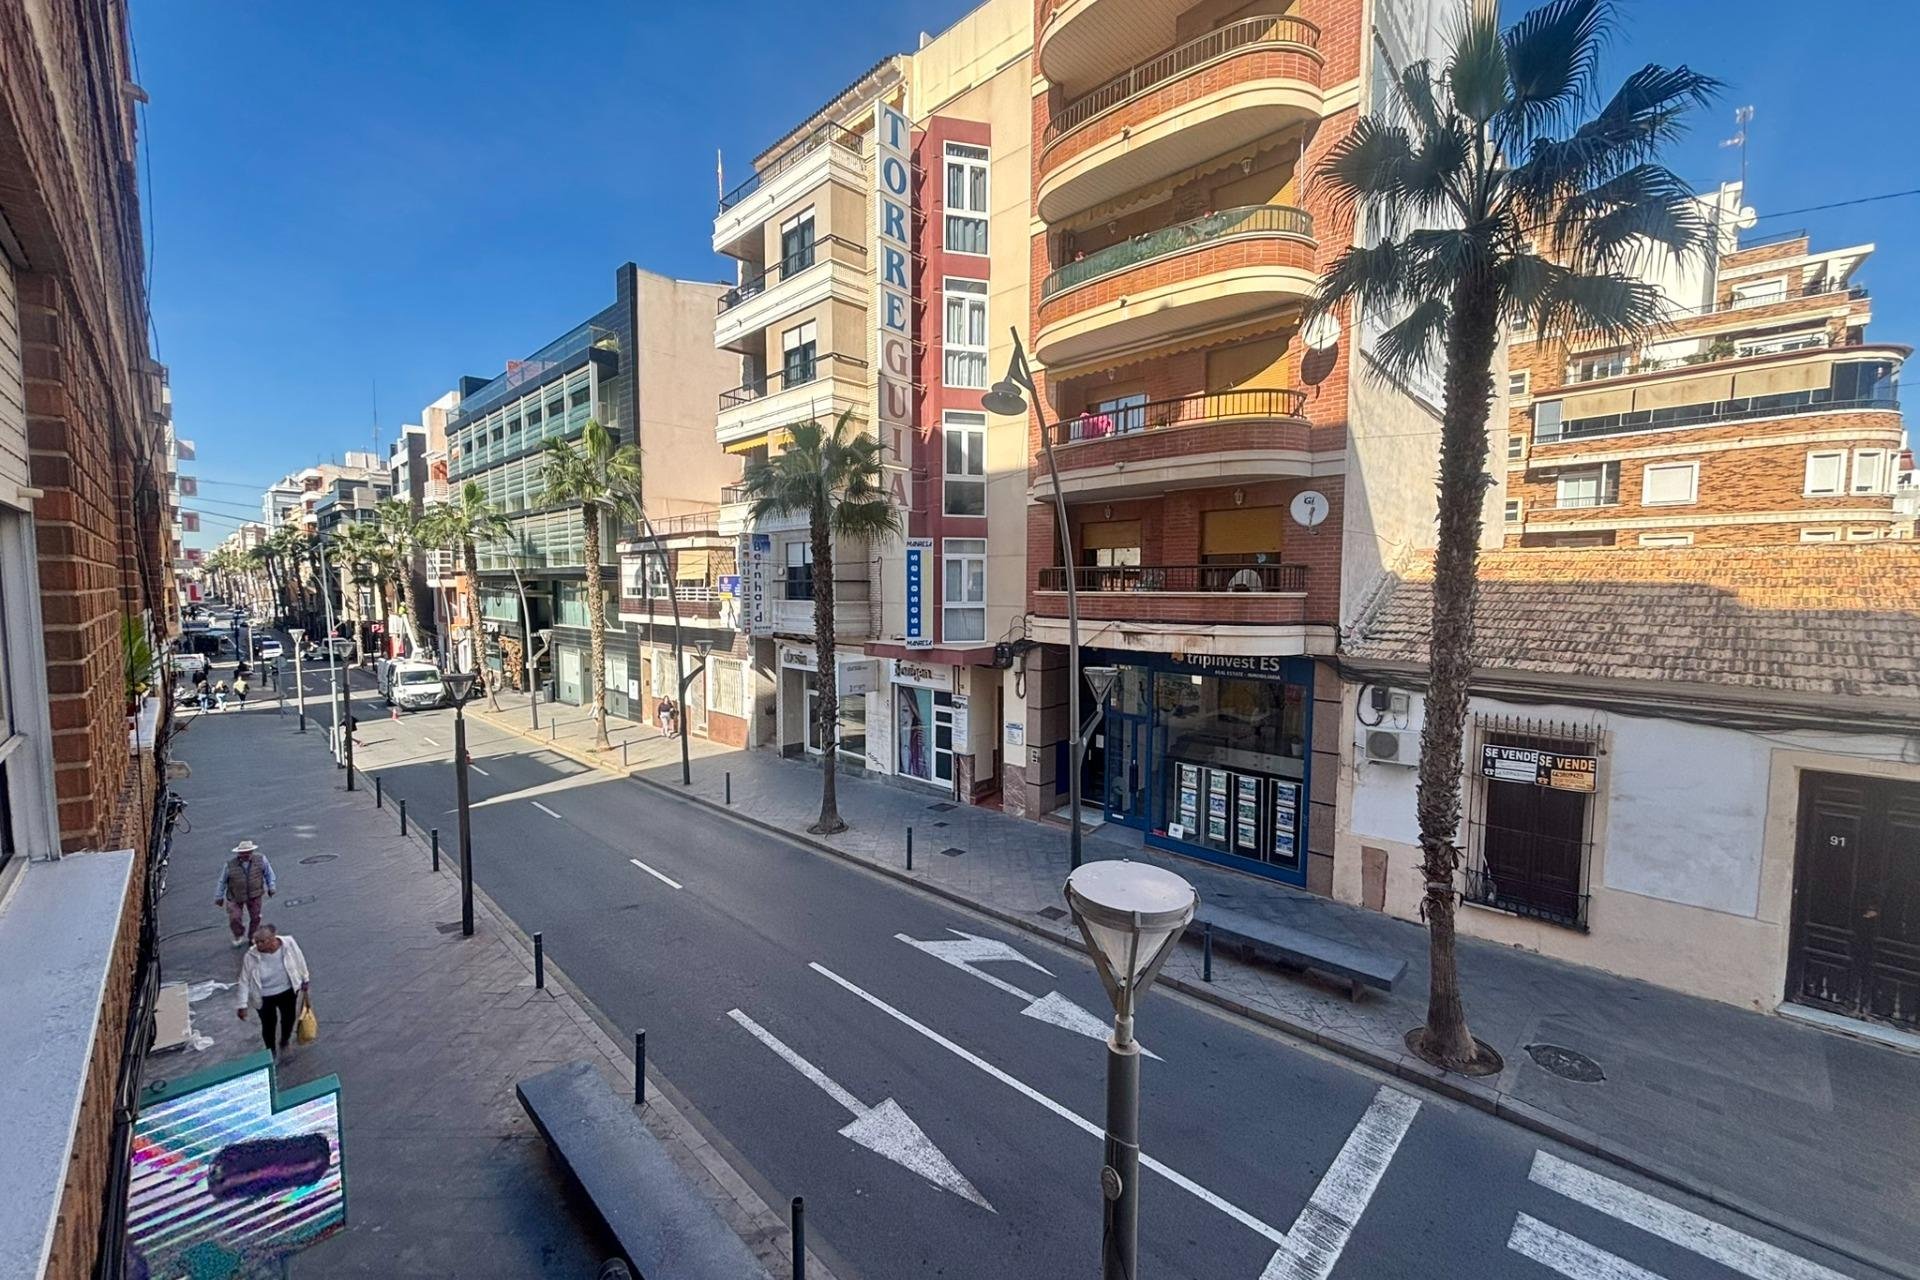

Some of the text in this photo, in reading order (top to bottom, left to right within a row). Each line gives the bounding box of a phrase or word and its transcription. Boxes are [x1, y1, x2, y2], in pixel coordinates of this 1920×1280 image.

[883, 108, 909, 507] TORREGUIA
[753, 541, 763, 623] Bernhard
[910, 554, 919, 635] asesores
[1187, 652, 1280, 671] tripinvest ES
[1485, 747, 1537, 762] SE VENDE
[1539, 755, 1552, 767] SE
[1557, 758, 1596, 771] VENDE
[1830, 836, 1845, 847] 91
